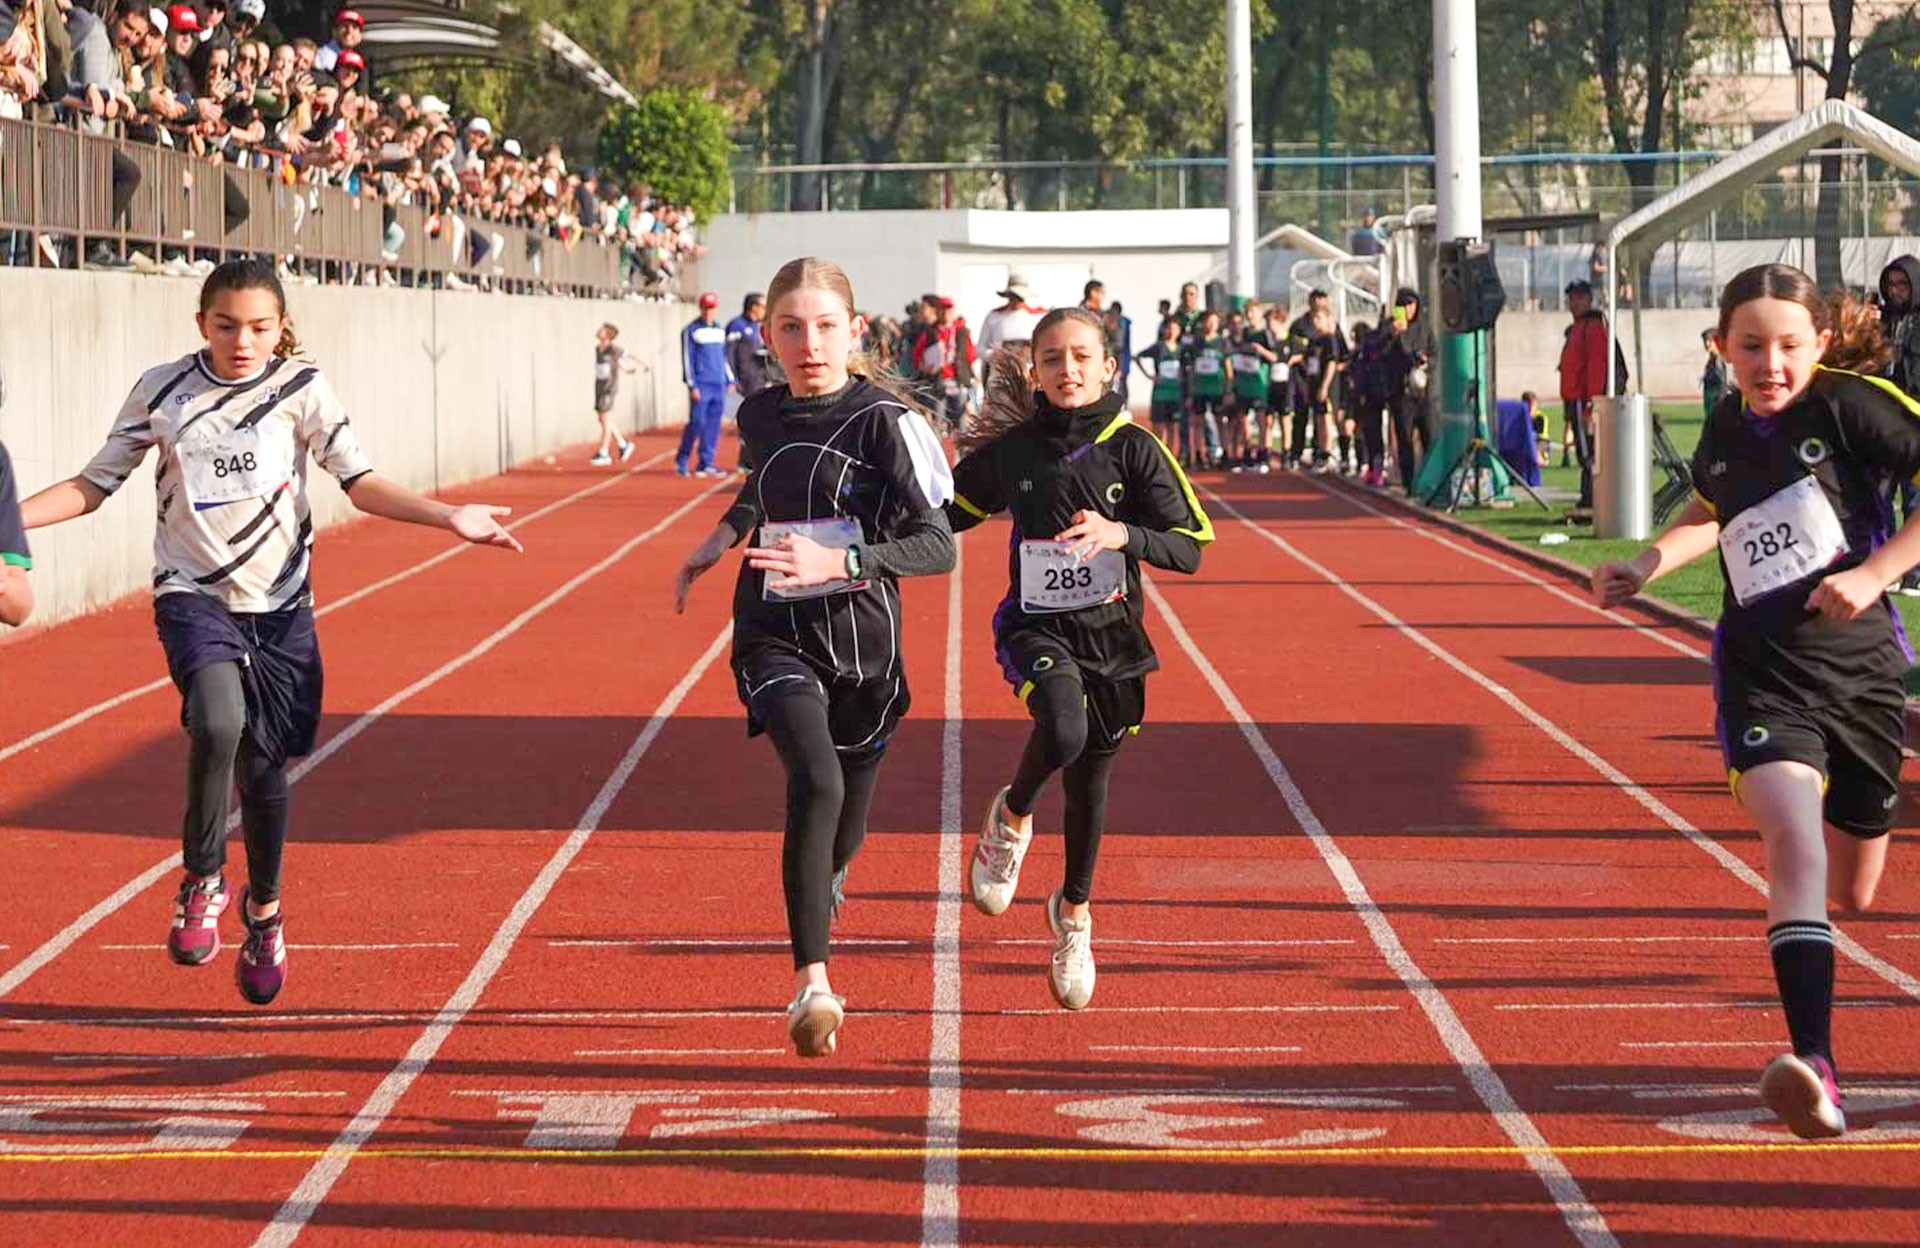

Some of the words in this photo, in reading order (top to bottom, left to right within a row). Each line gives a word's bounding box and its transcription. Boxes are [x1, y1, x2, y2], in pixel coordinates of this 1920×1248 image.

[213, 451, 257, 478] 848
[1743, 522, 1799, 567] 282
[1044, 566, 1092, 590] 283
[497, 1094, 837, 1148] 4
[1055, 1095, 1410, 1148] 3
